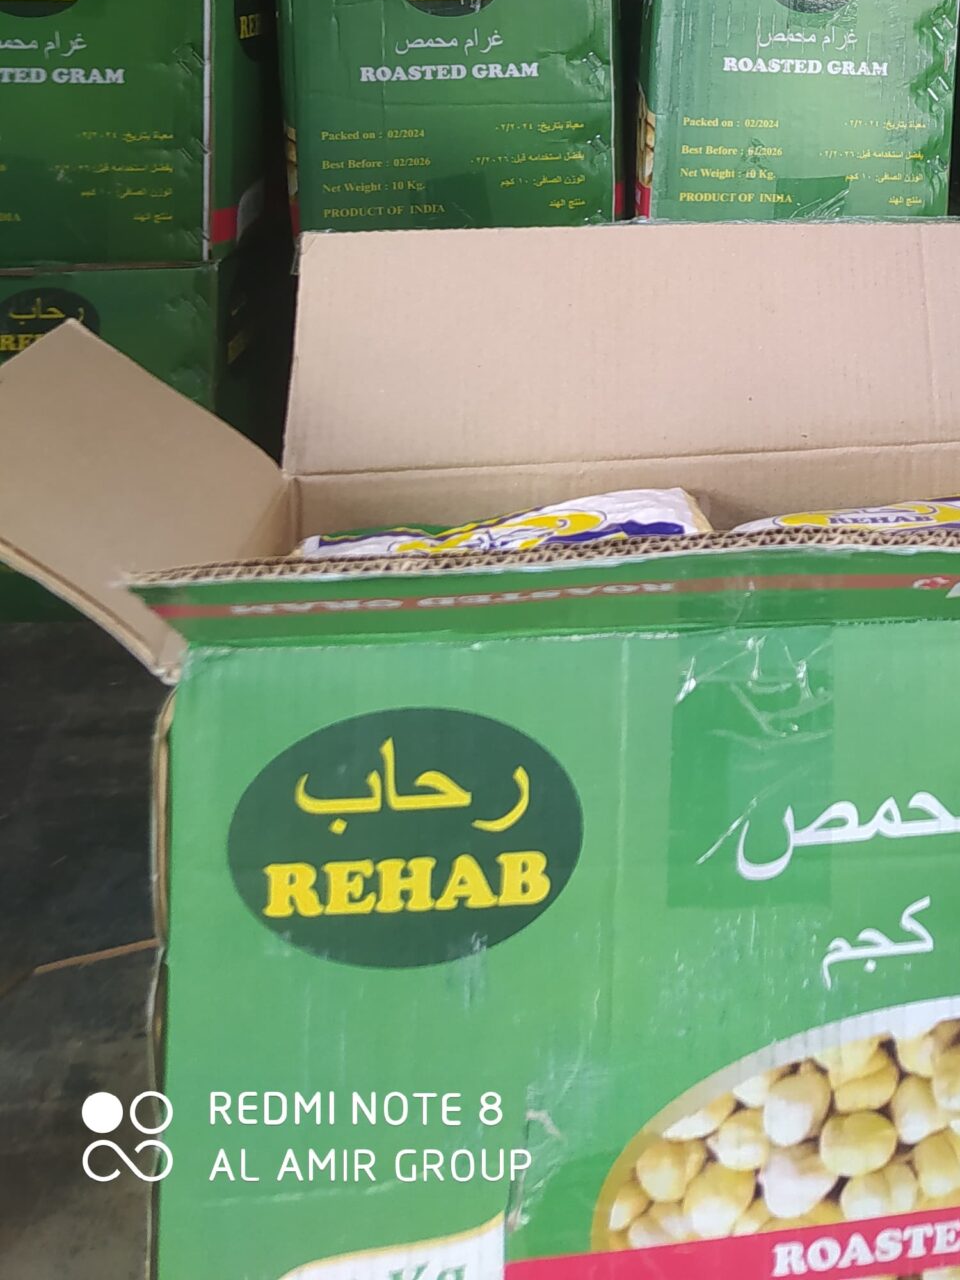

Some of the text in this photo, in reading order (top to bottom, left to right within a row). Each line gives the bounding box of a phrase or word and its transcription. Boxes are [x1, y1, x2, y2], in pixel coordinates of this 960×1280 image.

[396, 29, 503, 55] غرام محمص
[360, 63, 538, 81] ROASTED GRAM
[724, 58, 888, 75] ROASTED GRAM
[52, 68, 124, 83] GRAM
[679, 192, 793, 203] PRODUCT OF INDIA
[323, 204, 445, 218] PRODUCT OF INDIA
[828, 514, 934, 525] REHAB
[296, 739, 529, 833] رحاب
[264, 851, 550, 917] REHAB
[822, 896, 934, 990] كجم
